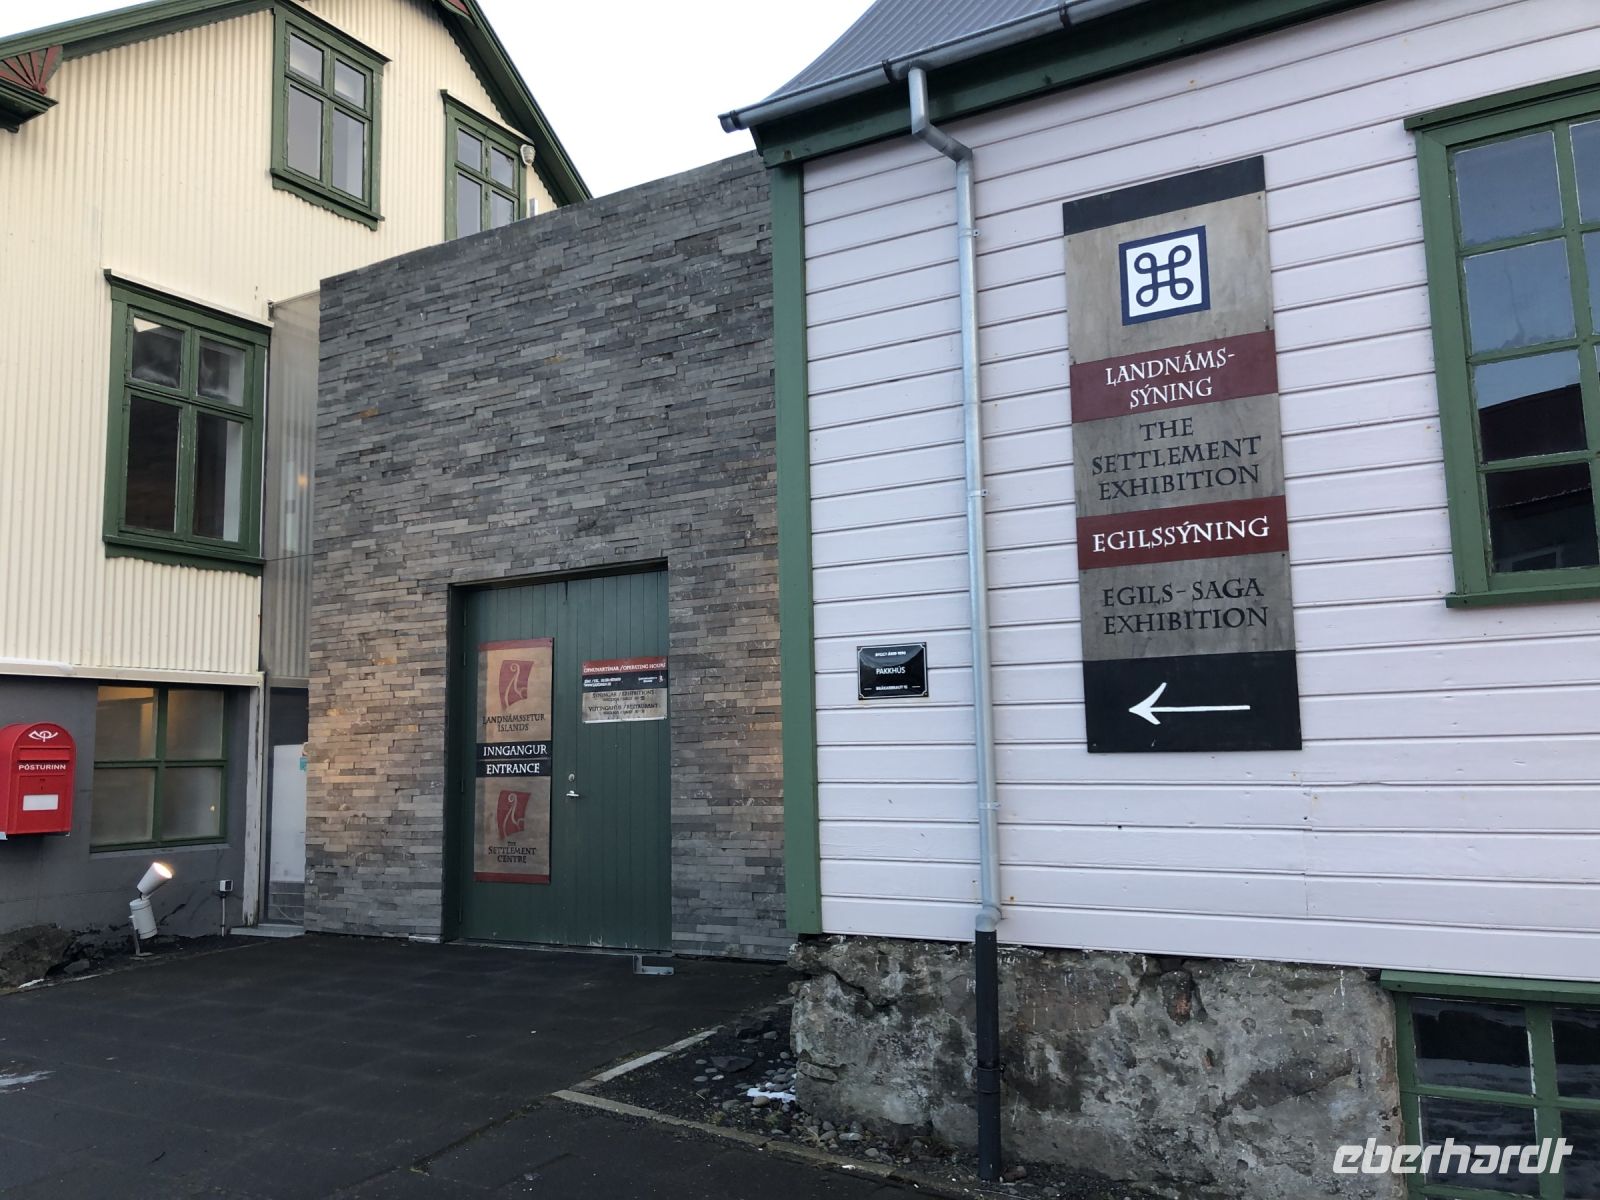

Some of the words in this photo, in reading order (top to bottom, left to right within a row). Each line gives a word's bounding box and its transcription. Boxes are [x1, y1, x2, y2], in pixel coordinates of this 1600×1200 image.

[1129, 377, 1213, 409] SÝNING
[1139, 416, 1193, 442] THE
[1091, 435, 1262, 476] SETTLEMENT
[1098, 464, 1260, 501] EXHIBITION
[1092, 515, 1270, 553] EGILSSÝNING
[1103, 606, 1268, 635] EXHIBITION
[483, 744, 548, 757] INNGANGUR
[18, 763, 66, 771] PÓSTURINN
[486, 762, 540, 775] ENTRANCE
[497, 855, 527, 864] CENTRE
